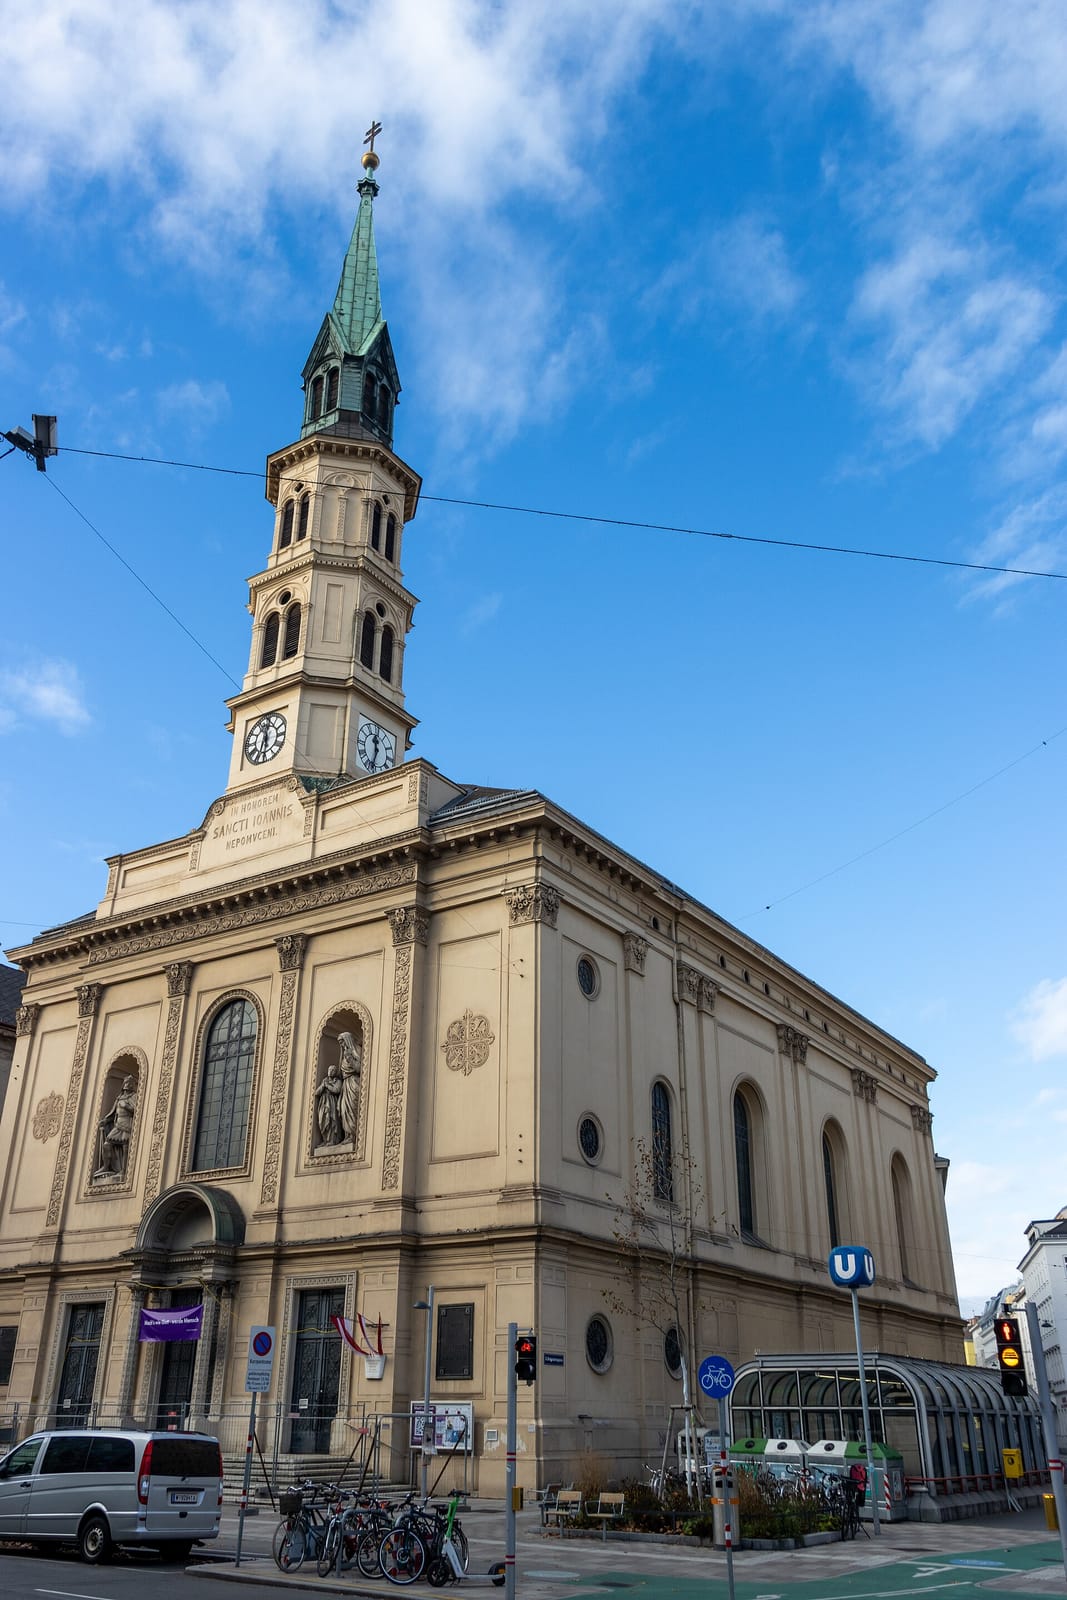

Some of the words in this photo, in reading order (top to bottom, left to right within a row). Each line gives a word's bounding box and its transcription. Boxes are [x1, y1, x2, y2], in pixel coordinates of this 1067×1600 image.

[231, 807, 238, 817] IN
[240, 793, 279, 814] HONOREM
[213, 818, 248, 840] SANCTI
[252, 804, 293, 826] IOANNIS
[834, 1254, 856, 1279] U
[864, 1254, 874, 1280] U
